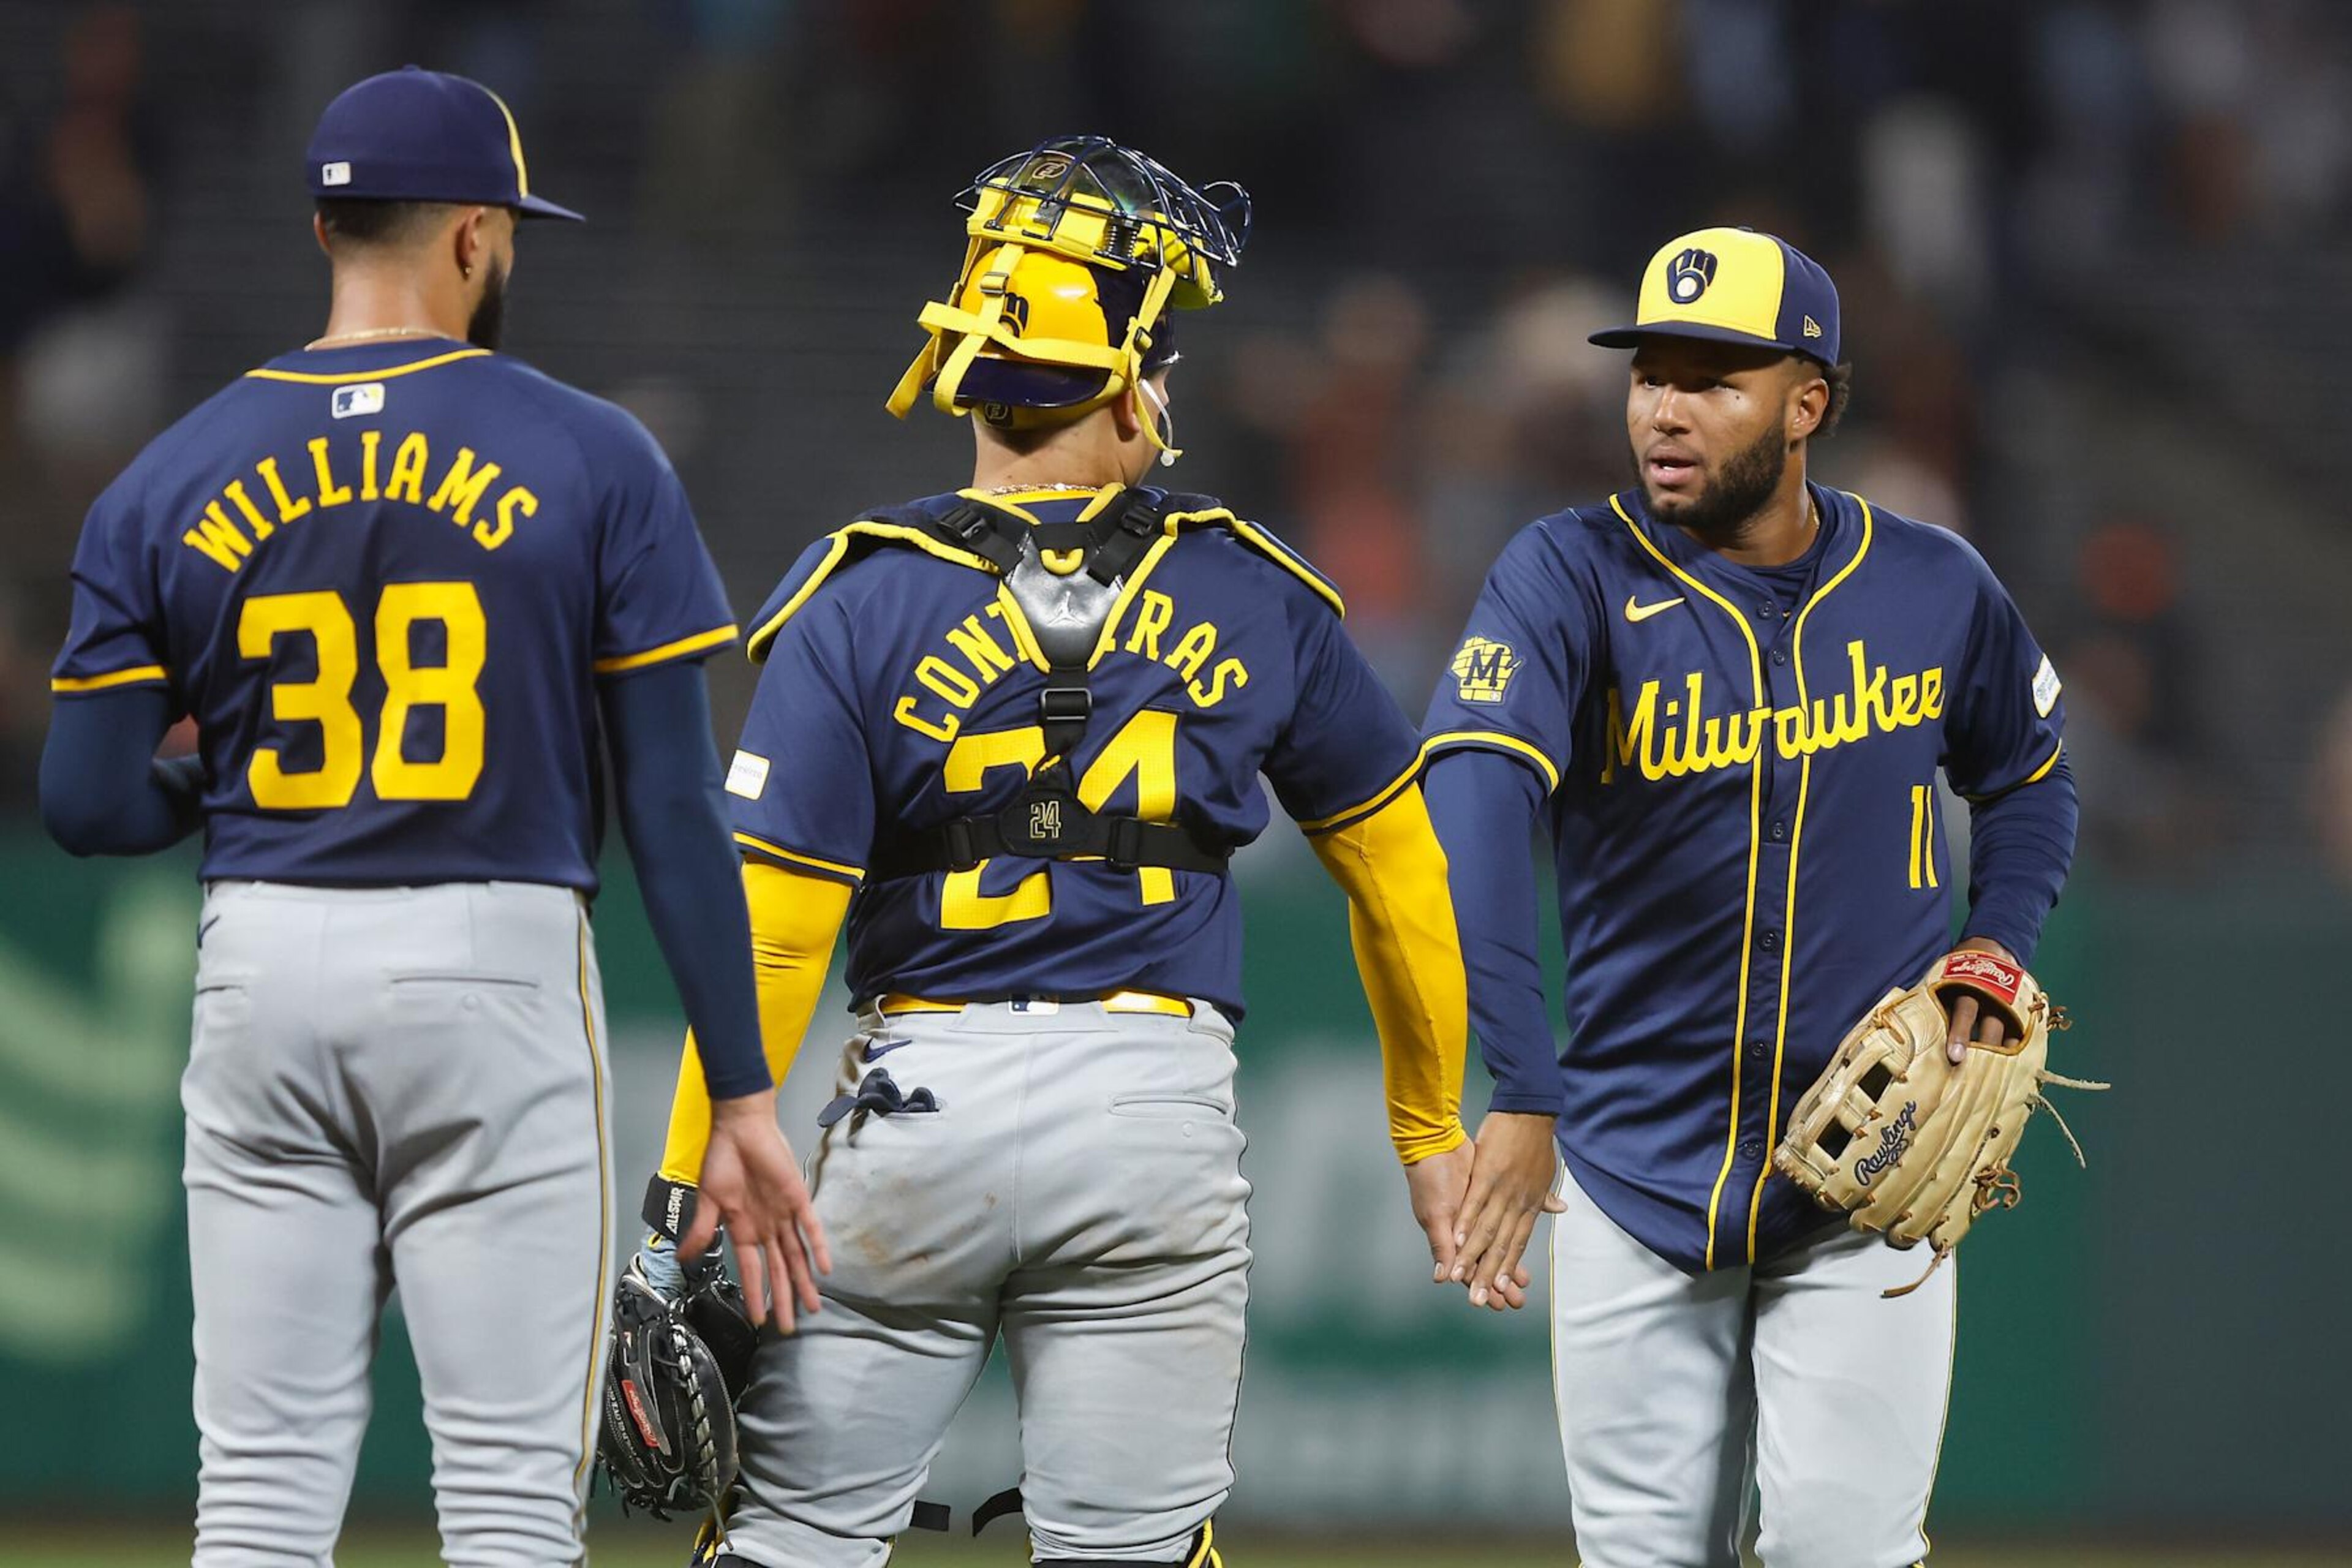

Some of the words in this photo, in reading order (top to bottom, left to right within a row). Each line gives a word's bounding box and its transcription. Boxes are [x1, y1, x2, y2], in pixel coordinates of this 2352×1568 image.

[182, 430, 540, 573] WILLIAMS
[236, 580, 488, 810] 38
[892, 589, 1250, 743] CONTRAS
[1600, 639, 1945, 785] Milwaukee
[1030, 801, 1062, 839] 24
[1909, 785, 1939, 889] 11
[1854, 1100, 1917, 1186] Rawlings
